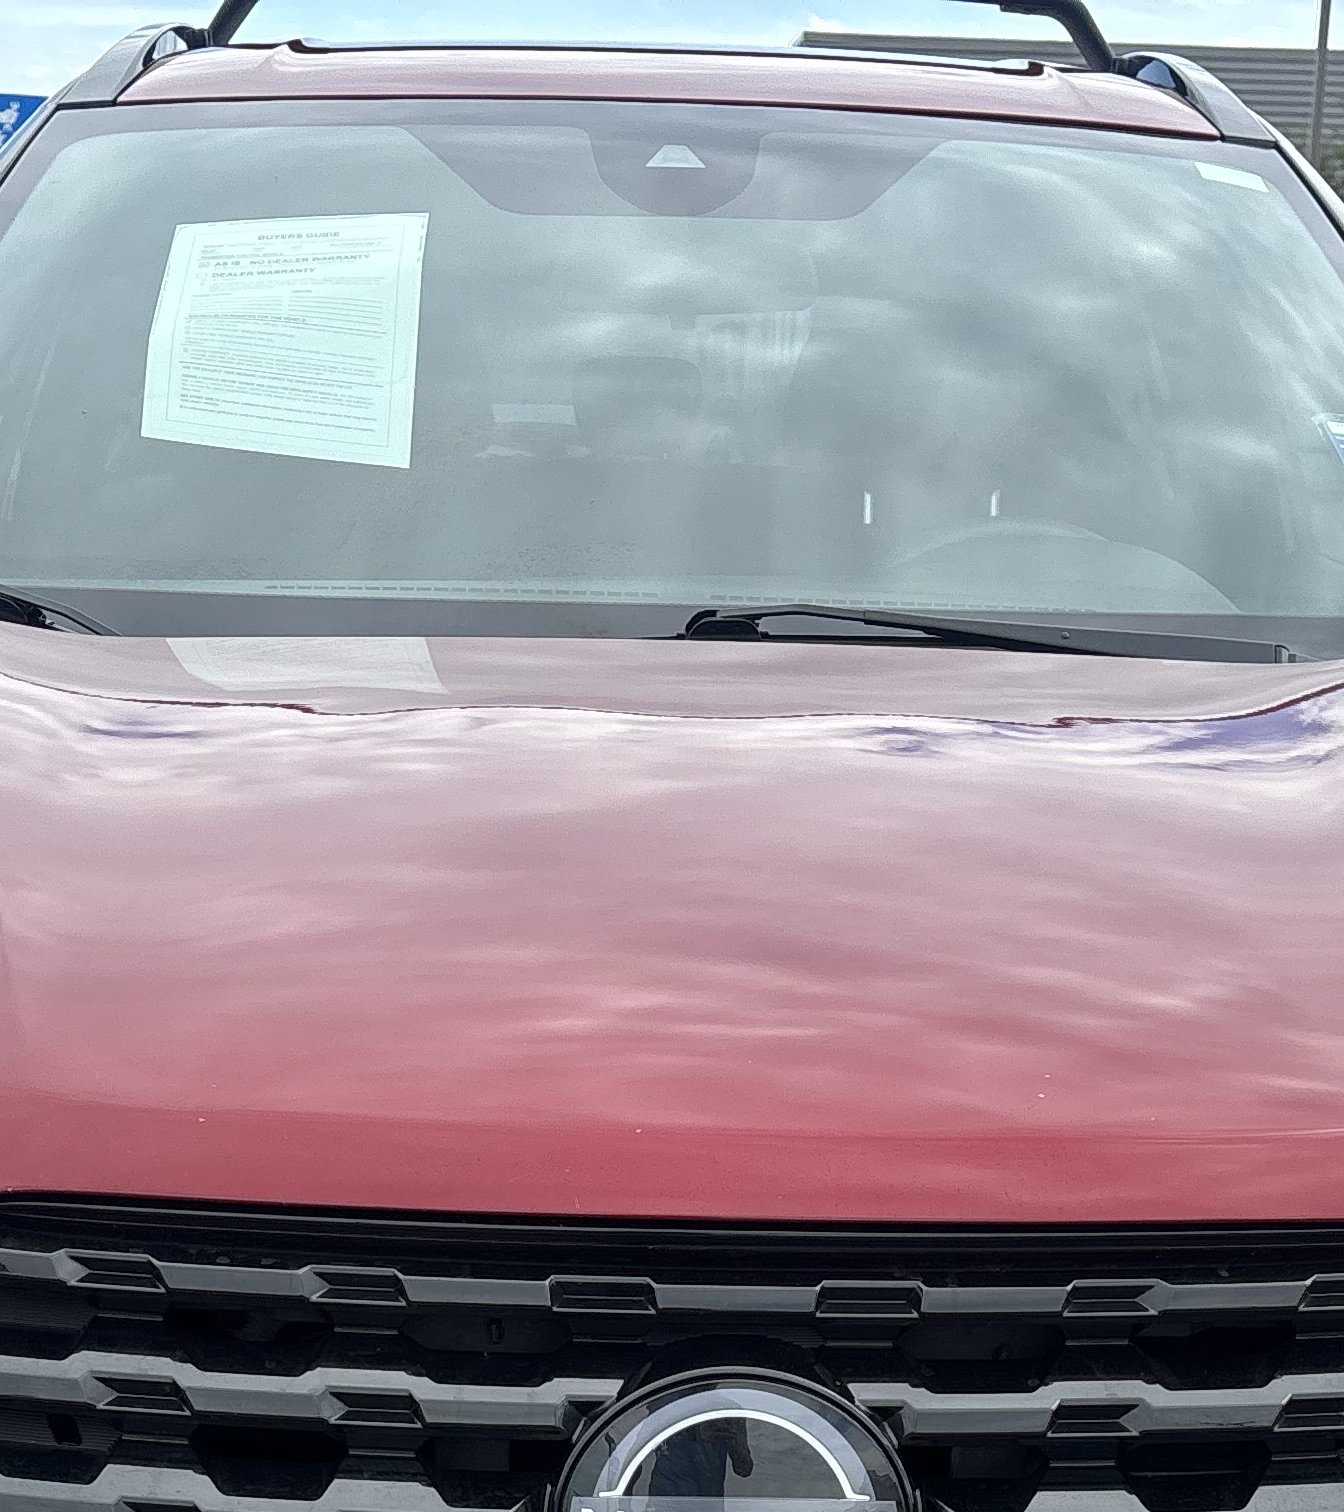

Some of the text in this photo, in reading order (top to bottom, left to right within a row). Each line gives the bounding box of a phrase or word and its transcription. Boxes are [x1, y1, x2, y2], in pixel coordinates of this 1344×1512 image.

[257, 231, 340, 241] BUYERS GUIDE
[268, 257, 309, 265] DEALER
[312, 254, 370, 262] WARRANTY
[211, 267, 316, 278] DEALER WARRANTY
